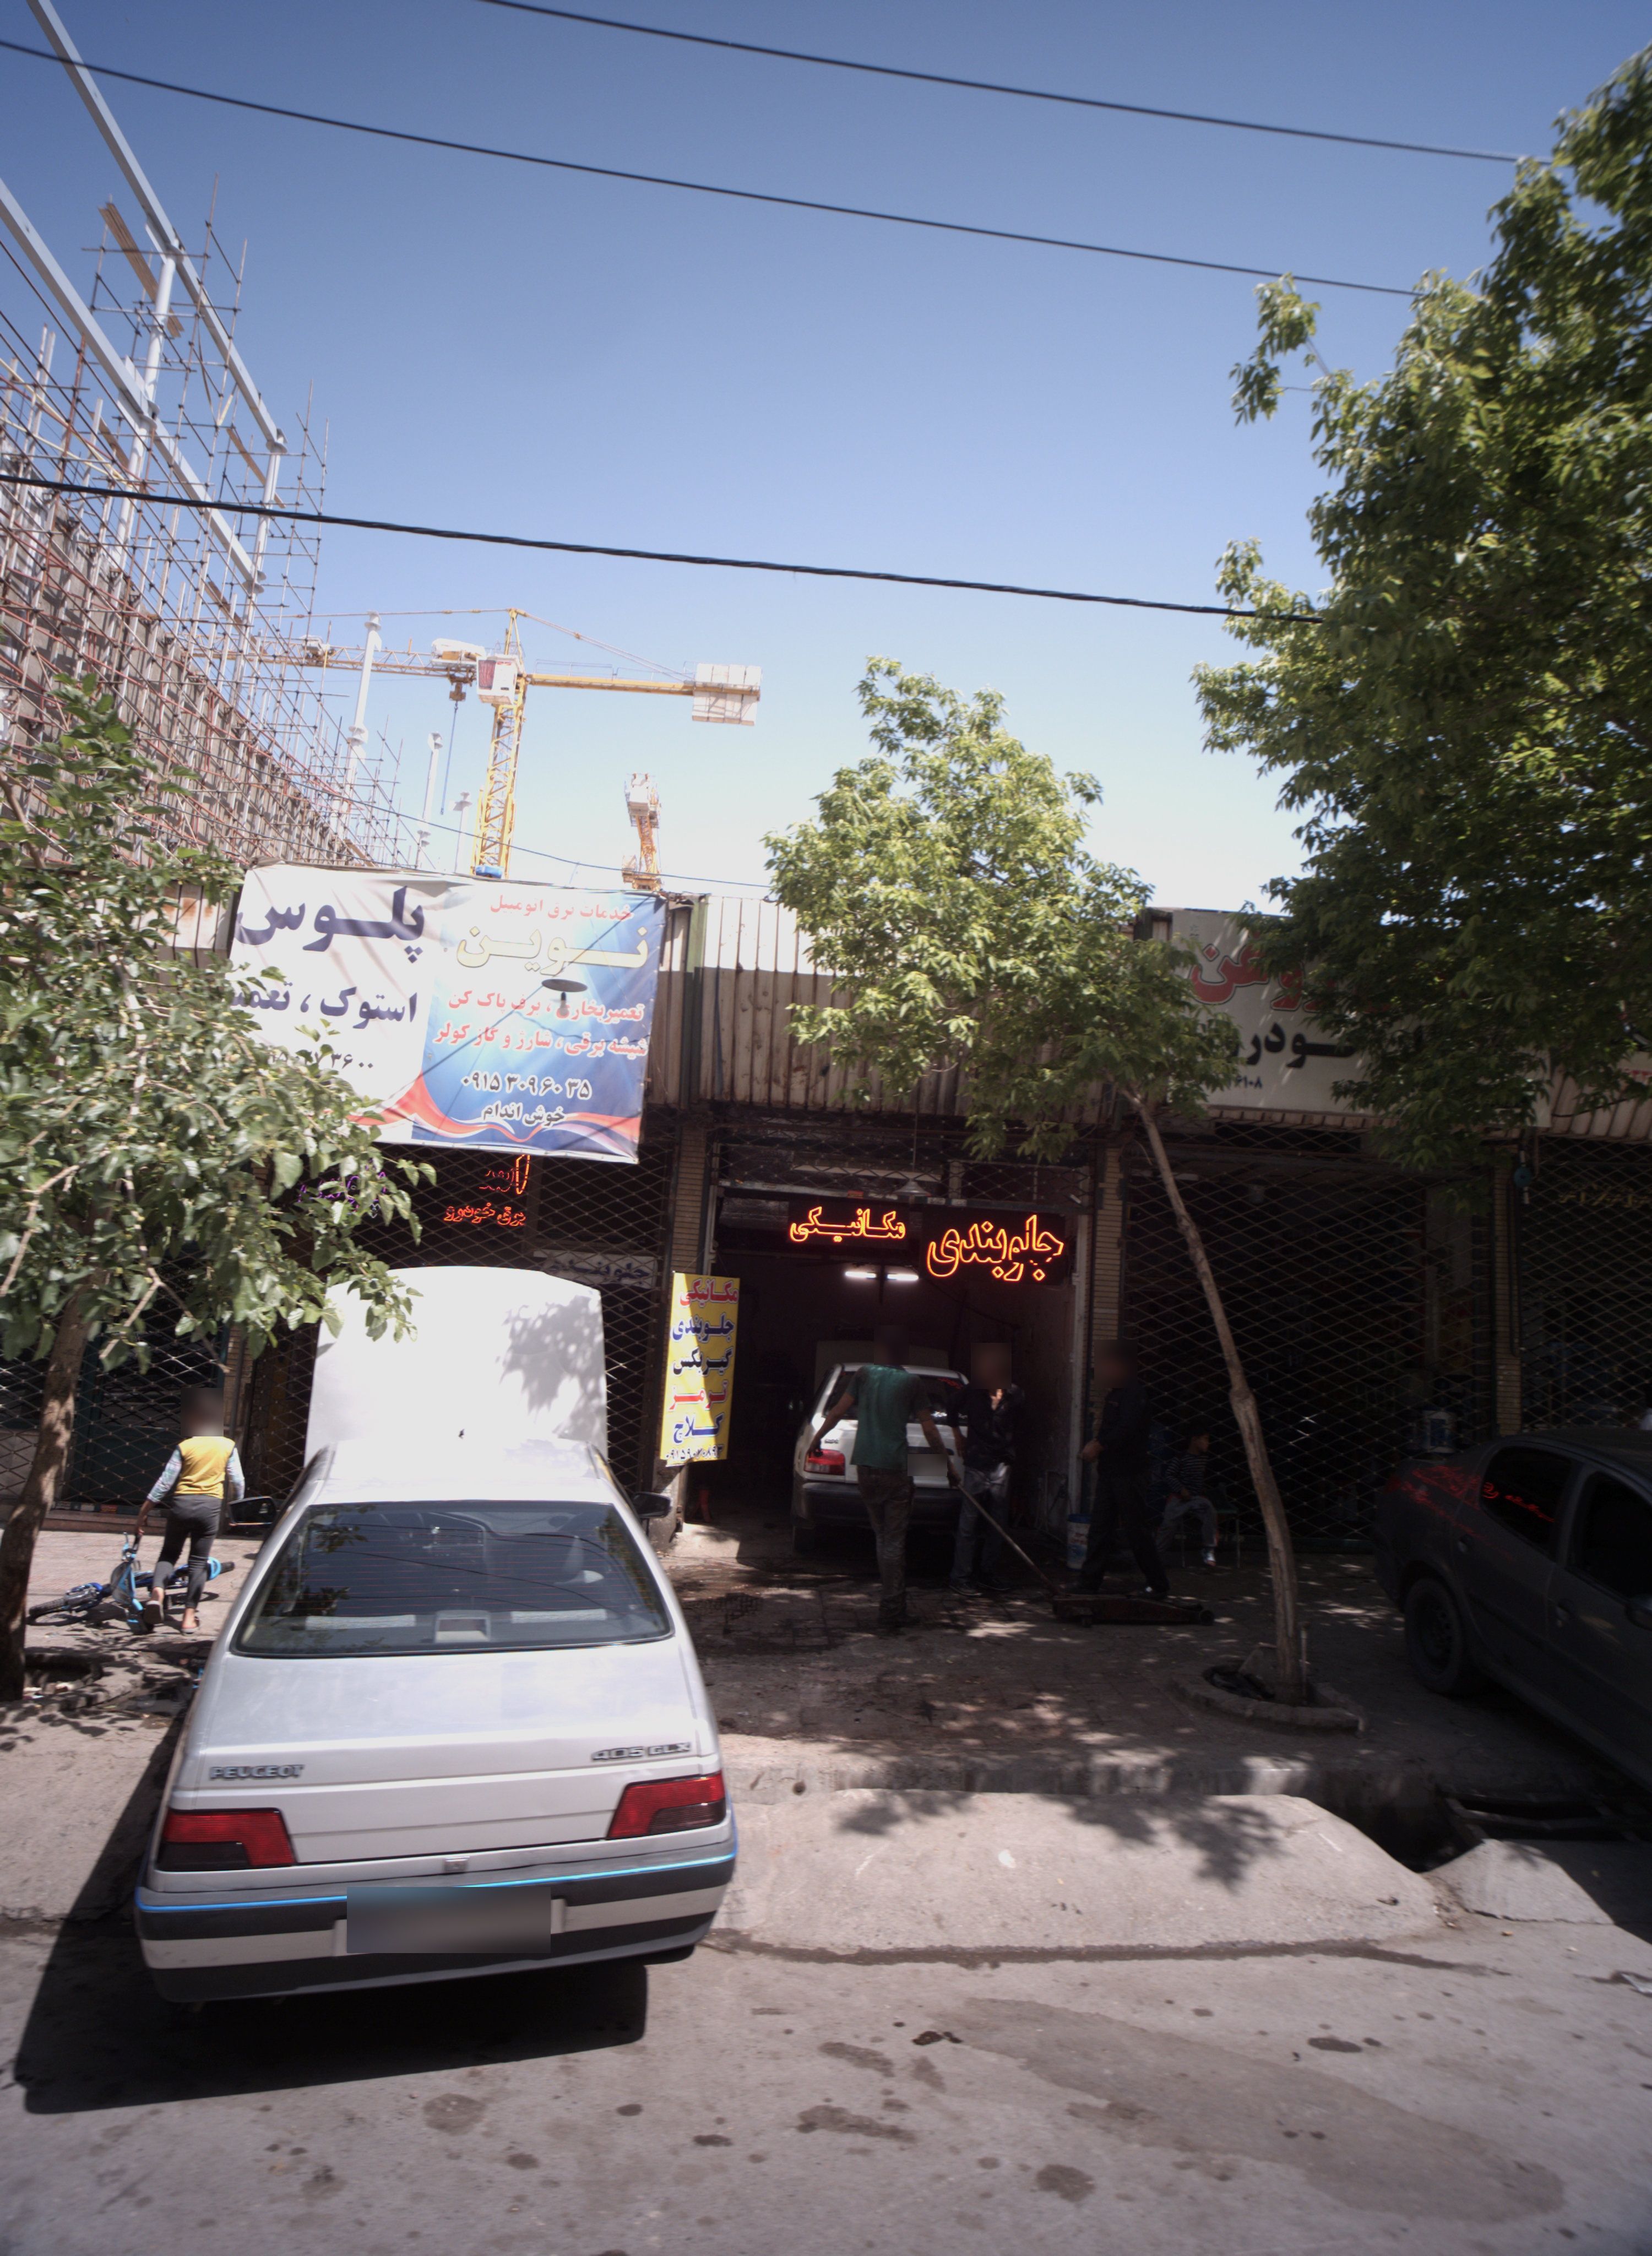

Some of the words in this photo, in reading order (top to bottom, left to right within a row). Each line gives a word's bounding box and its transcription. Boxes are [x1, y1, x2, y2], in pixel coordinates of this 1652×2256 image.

[547, 903, 574, 920] برق
[579, 904, 632, 920] خدمات
[235, 886, 425, 963] پلوس
[457, 926, 648, 976] نوین
[319, 986, 417, 1029] استوک
[448, 990, 472, 1009] کن
[477, 992, 506, 1015] پاک
[511, 994, 541, 1016] برف
[434, 1022, 470, 1044] کولر
[474, 1026, 498, 1045] گاز
[502, 1034, 511, 1049] و
[515, 1030, 551, 1050] شارژ
[565, 1031, 606, 1056] برقی
[608, 1036, 648, 1059] شیشه
[483, 1103, 521, 1120] اندام
[524, 1107, 565, 1126] خوش
[790, 1206, 906, 1243] مکانیکی
[926, 1214, 1064, 1282] جلوبندی
[680, 1279, 738, 1306] مکانیکی
[672, 1313, 734, 1342] جلوبندی
[673, 1347, 733, 1375] گیربکس
[669, 1381, 726, 1410] ترمز
[591, 1746, 644, 1761] 405
[648, 1742, 691, 1756] GLX
[209, 1764, 305, 1780] PEUGEOT
